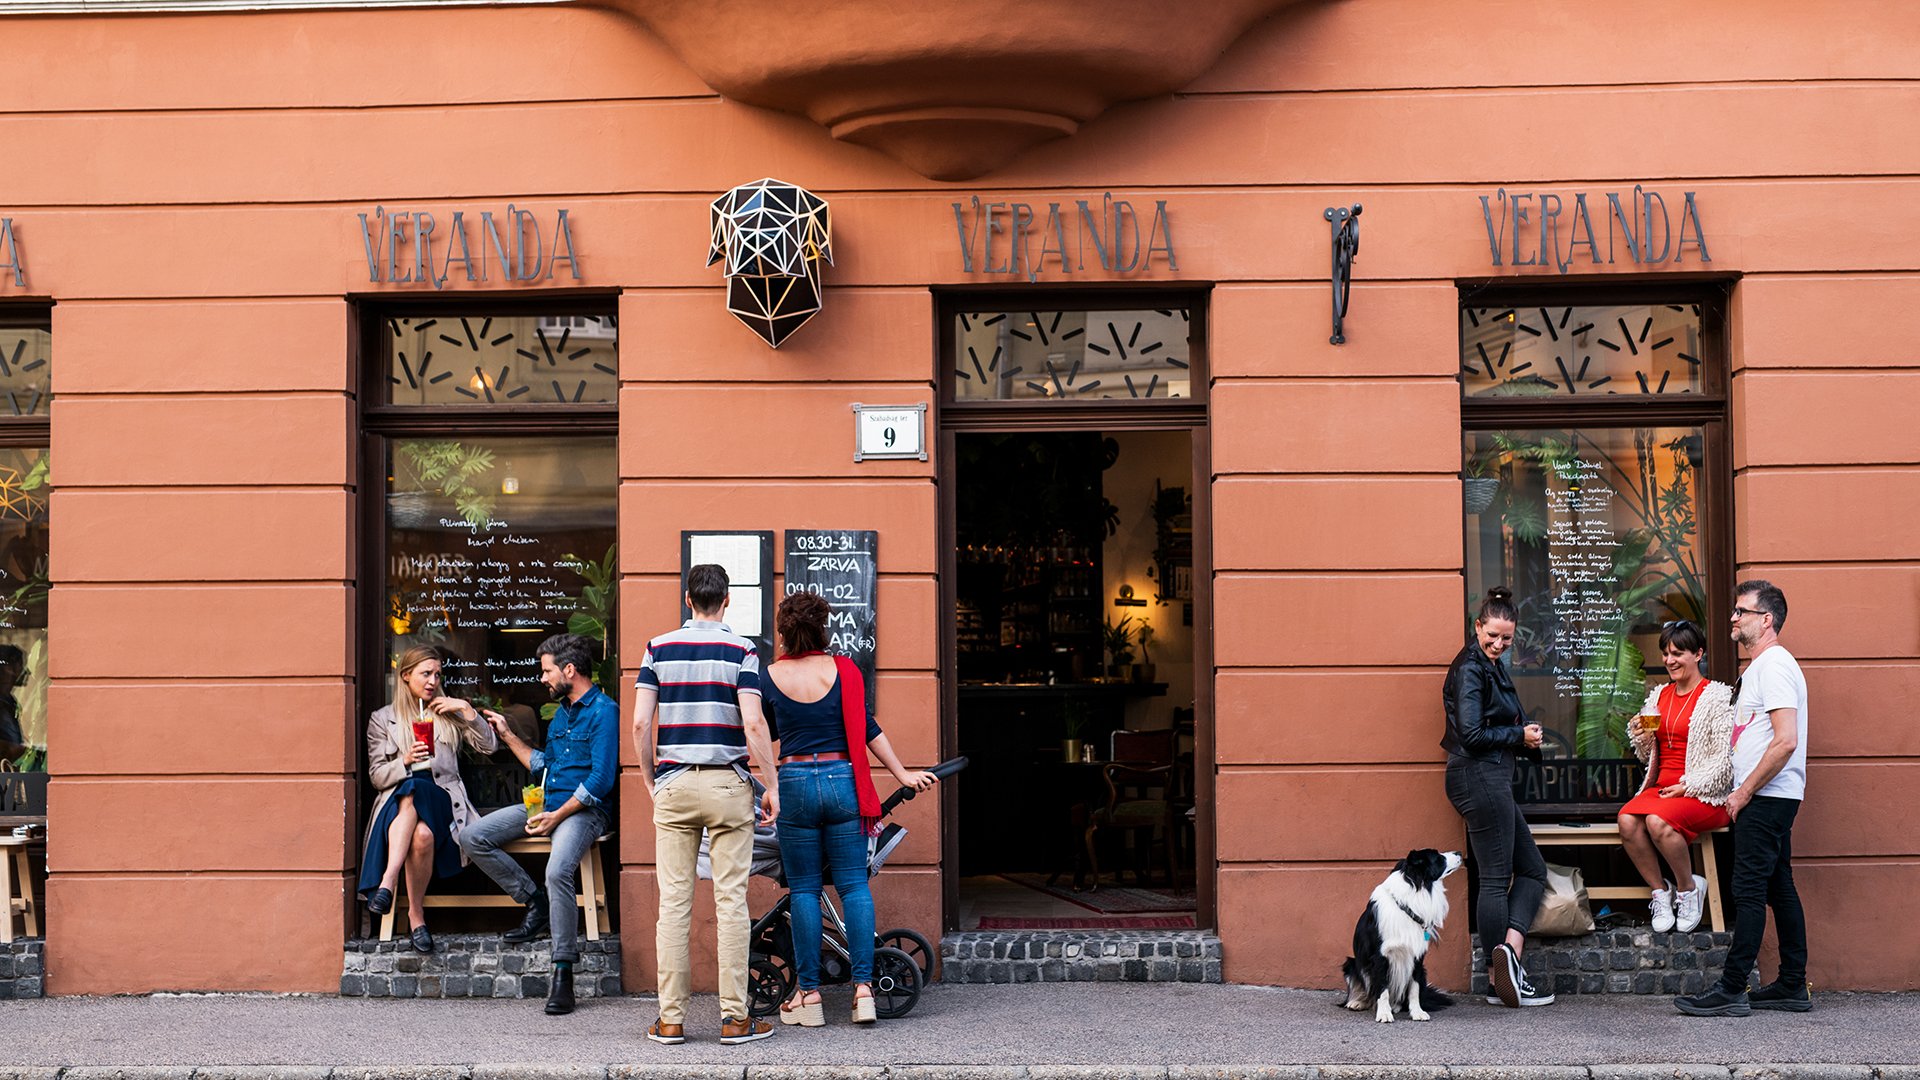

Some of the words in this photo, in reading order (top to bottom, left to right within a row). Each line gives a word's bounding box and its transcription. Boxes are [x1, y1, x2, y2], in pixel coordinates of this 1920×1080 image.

[952, 192, 1179, 283] VERANDA
[1480, 184, 1712, 275] VERANDA
[357, 204, 582, 289] VERANDA
[883, 427, 896, 448] 9
[808, 556, 861, 573] ZÁRVA
[823, 612, 857, 629] MA
[829, 632, 860, 652] AR
